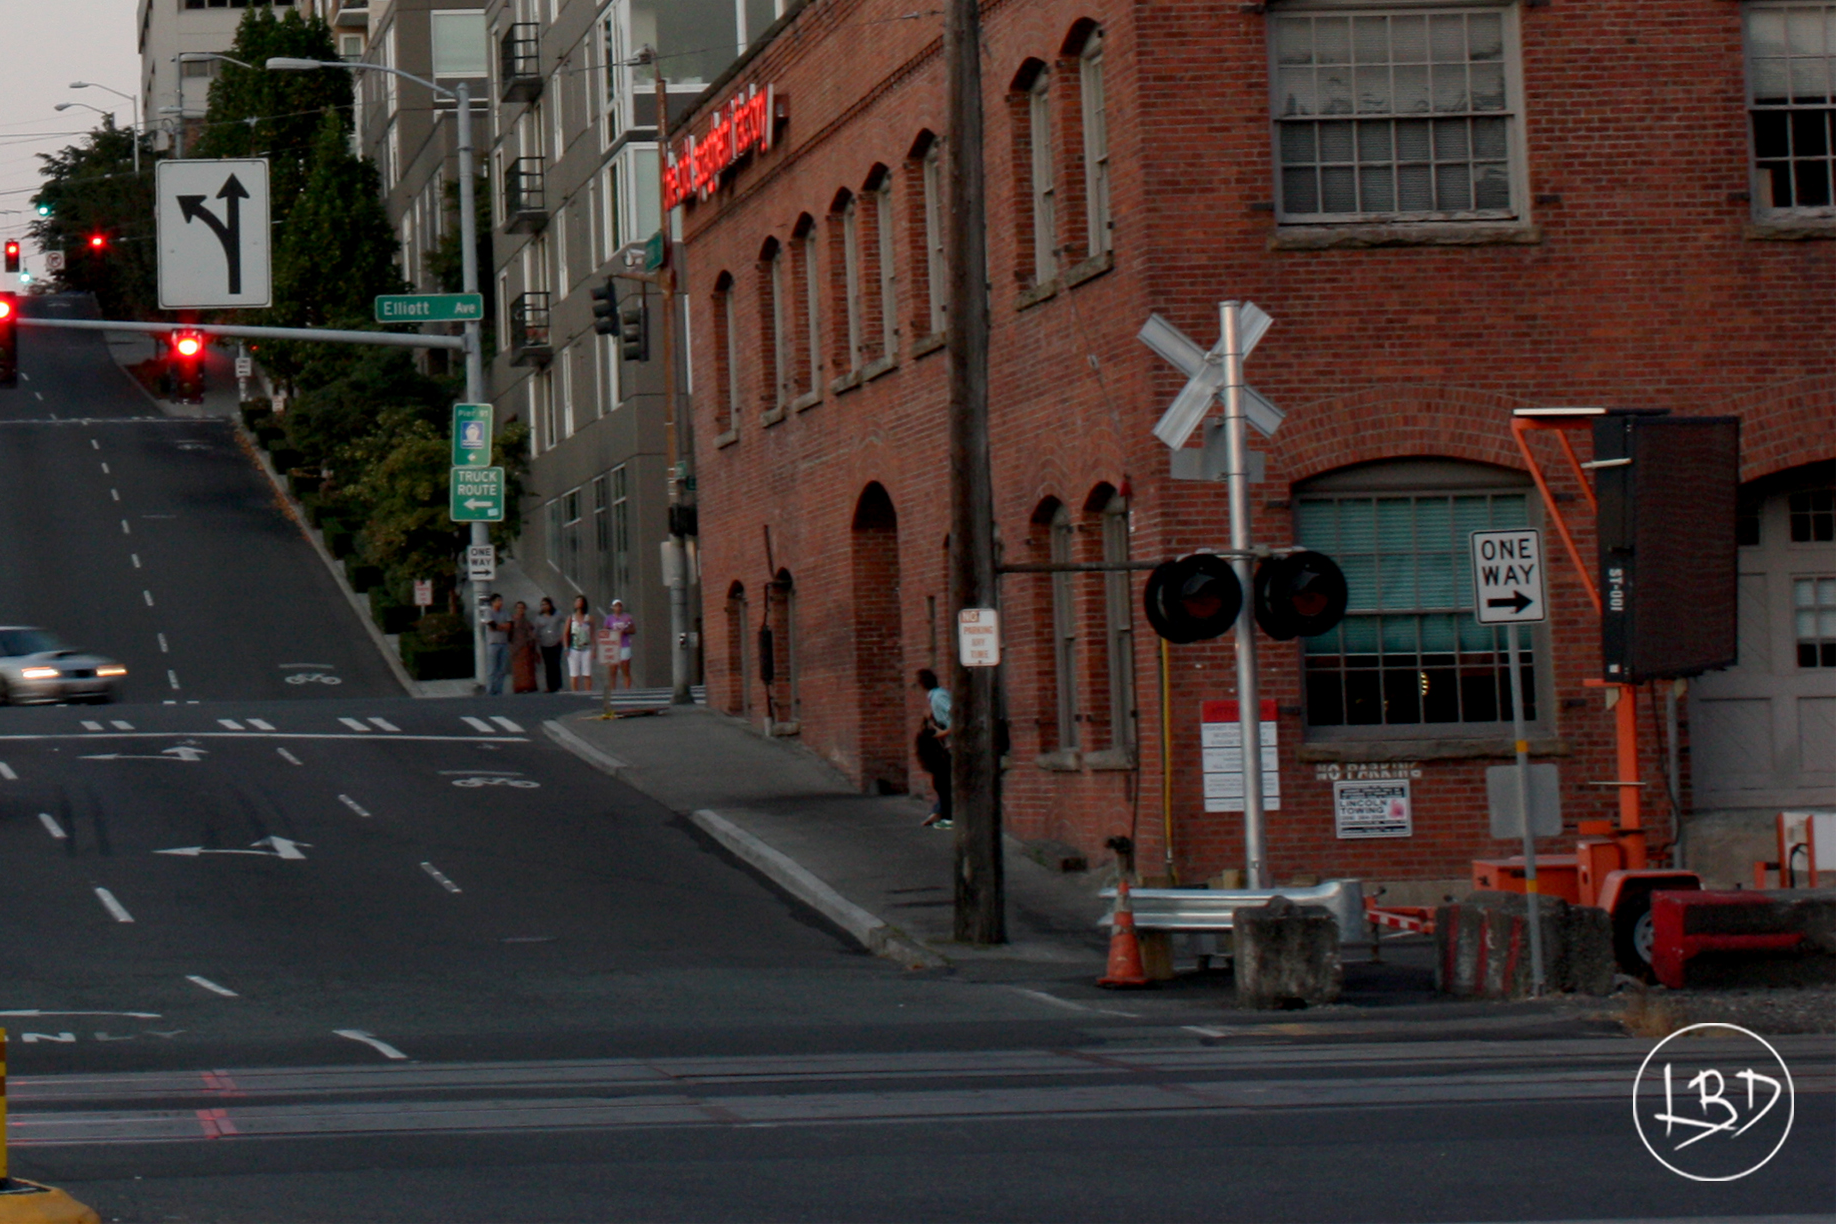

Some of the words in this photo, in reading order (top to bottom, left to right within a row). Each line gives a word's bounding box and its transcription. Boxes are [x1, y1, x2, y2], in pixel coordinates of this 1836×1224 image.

[383, 301, 430, 316] Elliott
[454, 302, 477, 314] Ave
[458, 470, 497, 482] TRUCK
[457, 484, 497, 496] ROUTE
[471, 548, 492, 556] ONE
[1481, 538, 1532, 561] ONE
[470, 558, 492, 566] WAY
[1482, 563, 1534, 586] WAY
[962, 611, 978, 622] NO
[1316, 763, 1341, 780] NO
[1347, 762, 1422, 779] PARKING
[1340, 799, 1388, 808] LINCOLN
[1341, 807, 1384, 815] TOWING
